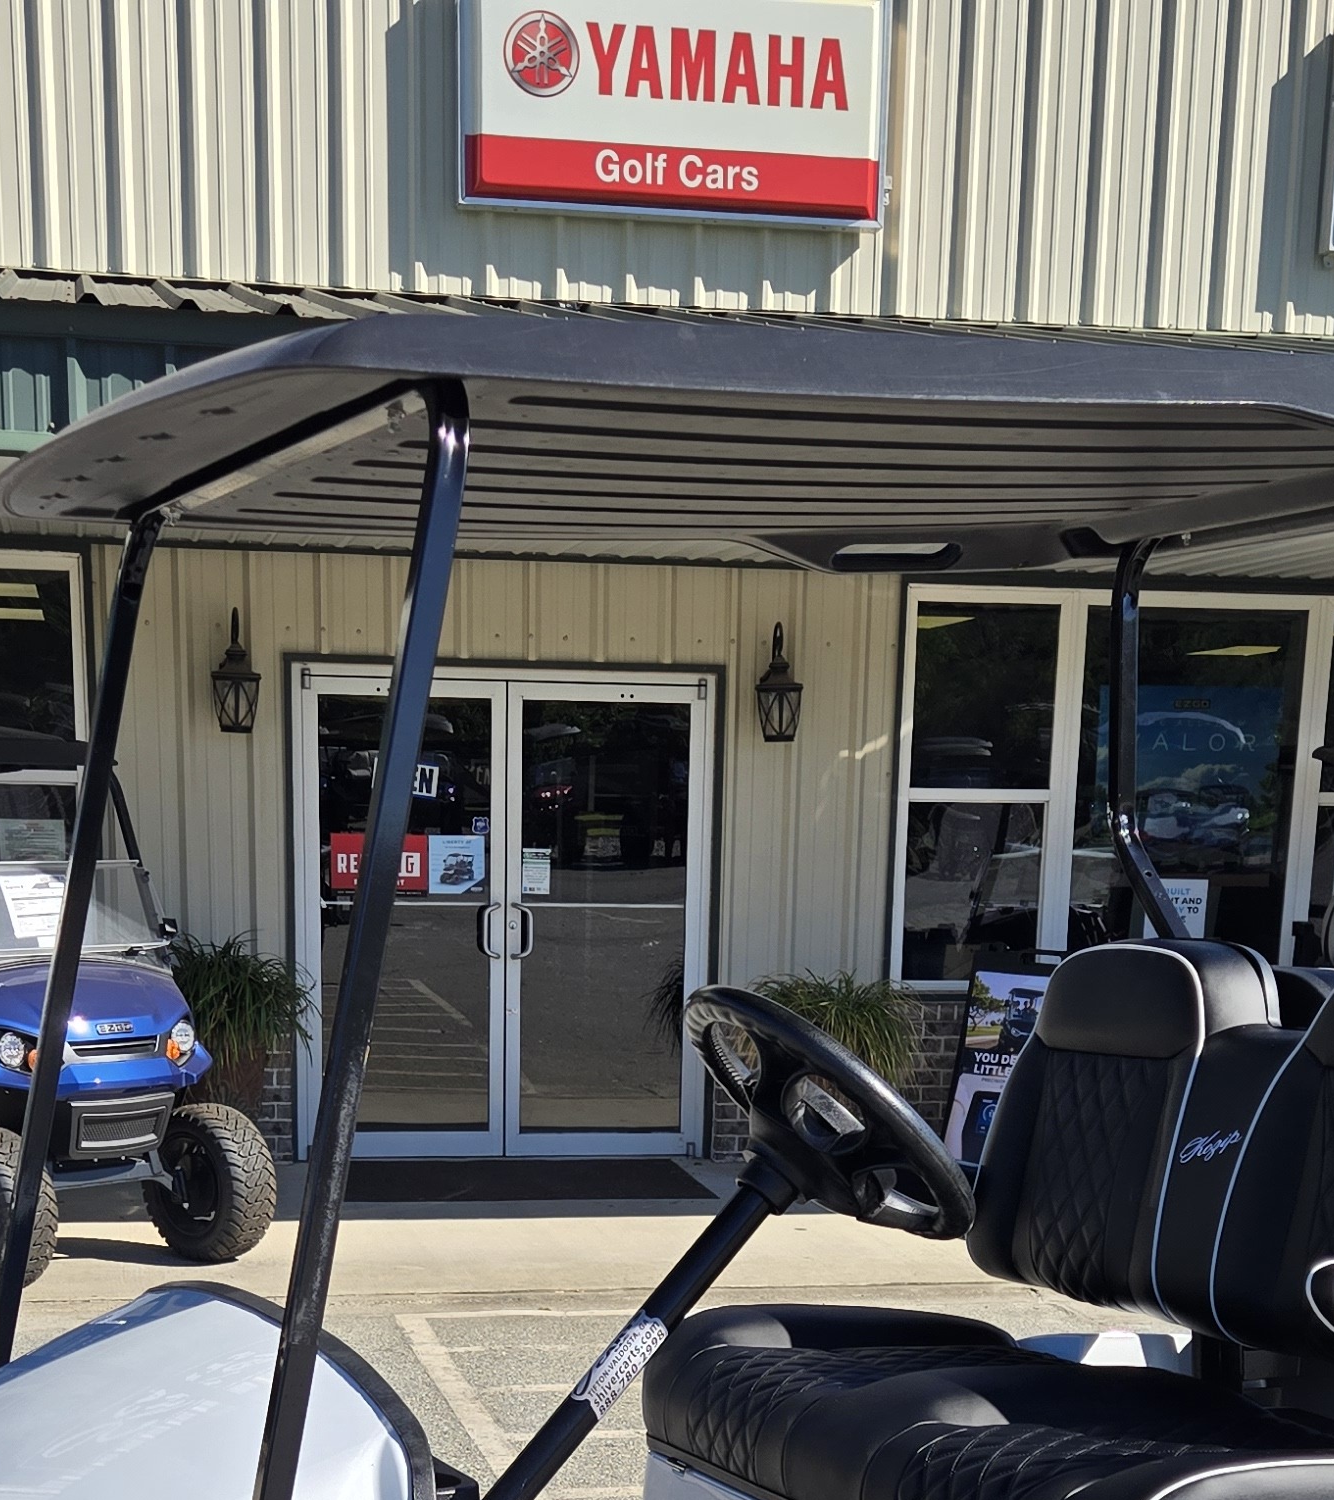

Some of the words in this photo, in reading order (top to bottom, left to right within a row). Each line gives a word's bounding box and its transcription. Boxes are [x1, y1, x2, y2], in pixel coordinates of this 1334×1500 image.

[585, 21, 849, 111] YAMAHA
[595, 149, 667, 186] Golf
[679, 154, 759, 191] Cars
[1182, 897, 1202, 905] AND
[1187, 906, 1199, 914] TO
[974, 1052, 999, 1065] YOU
[594, 1321, 660, 1407] shivercarts.com
[598, 1329, 665, 1416] 888-780-2998
